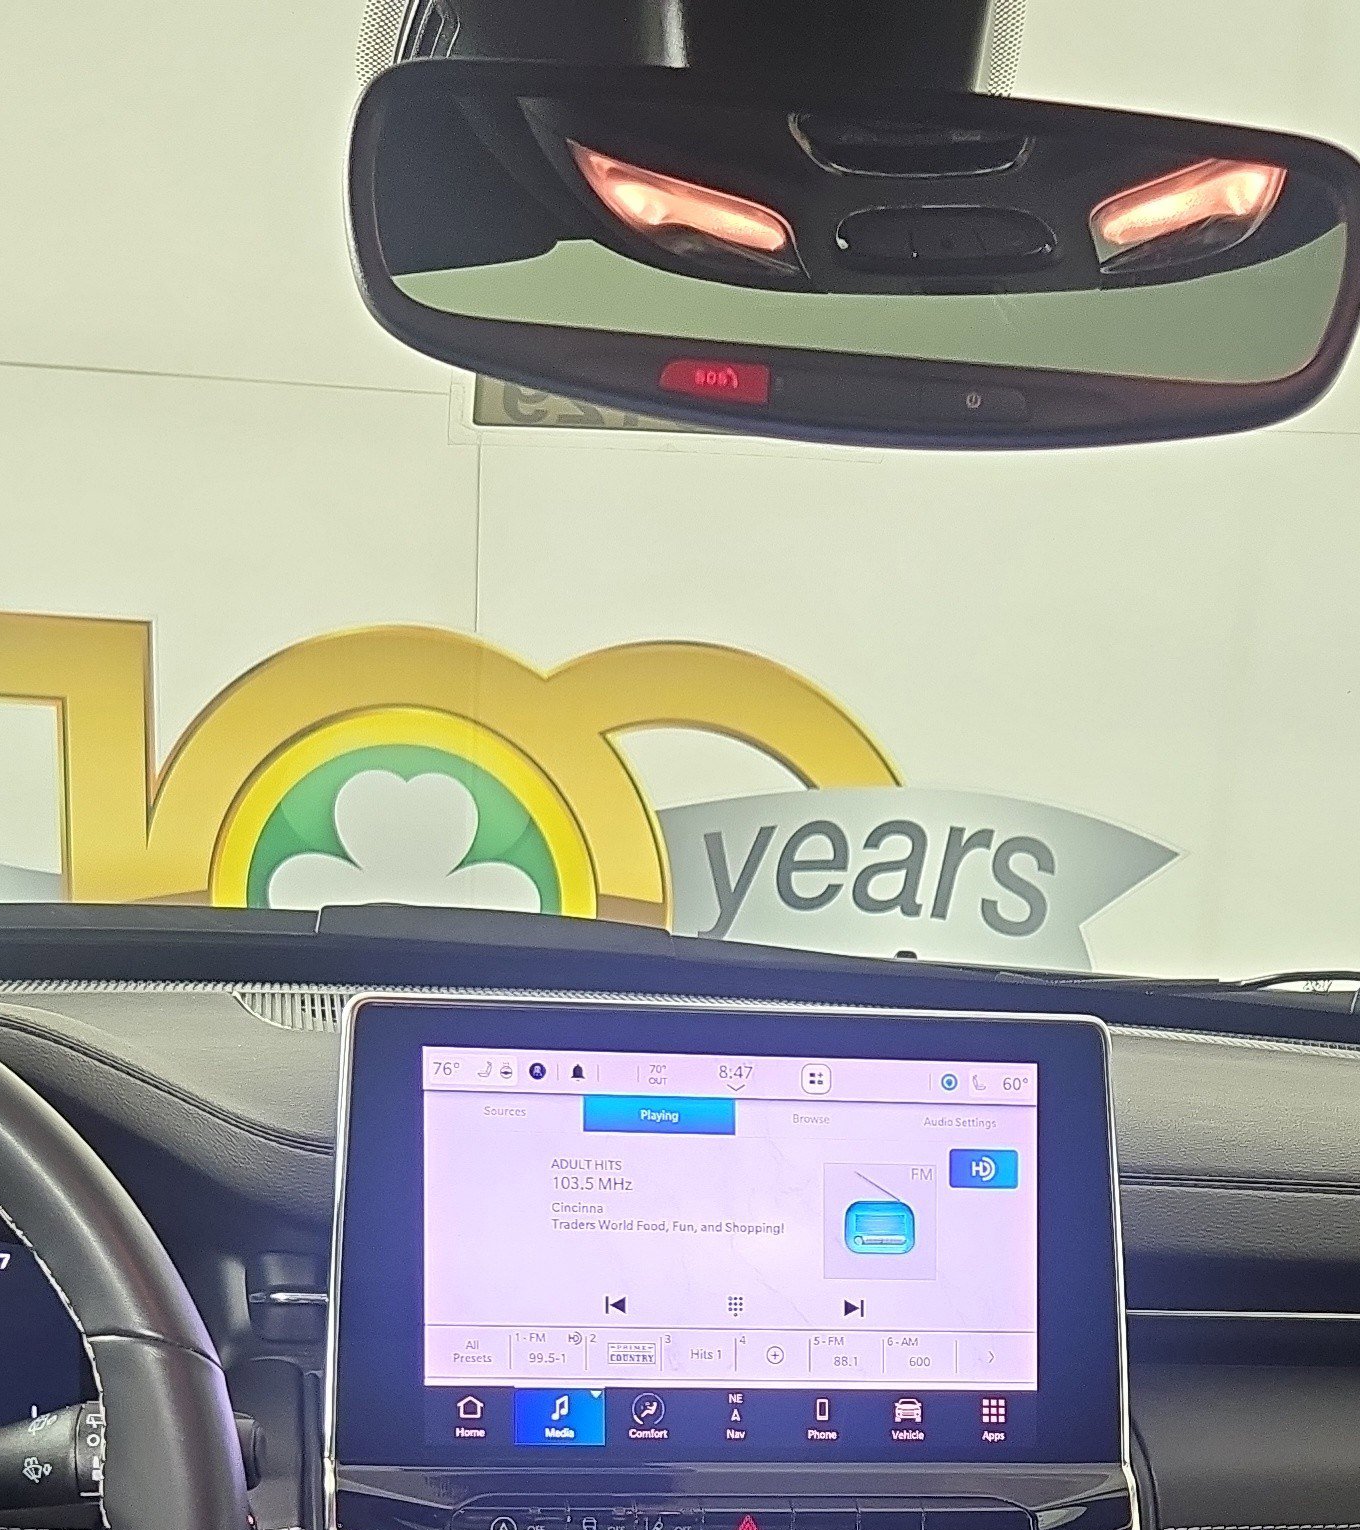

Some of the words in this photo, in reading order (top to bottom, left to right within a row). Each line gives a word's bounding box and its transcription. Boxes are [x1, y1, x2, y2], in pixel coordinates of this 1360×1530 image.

[696, 818, 1057, 936] years
[719, 1065, 753, 1080] 8:47
[648, 1077, 667, 1086] OUT
[484, 1106, 527, 1117] Sources
[640, 1109, 679, 1122] Playing
[792, 1114, 830, 1125] Browse
[923, 1117, 953, 1128] Audio
[955, 1118, 997, 1130] Settings
[551, 1158, 592, 1170] ADULT
[595, 1160, 622, 1171] HITS
[911, 1168, 933, 1181] FM
[553, 1176, 594, 1190] 103.5
[598, 1178, 633, 1191] MHz
[551, 1202, 604, 1214] Cincinna
[551, 1219, 596, 1231] Traders
[598, 1219, 634, 1231] World
[636, 1221, 669, 1233] Food,
[673, 1221, 698, 1233] Fun,
[700, 1222, 723, 1232] and
[725, 1222, 785, 1235] Shopping!
[590, 1334, 597, 1343] 2
[664, 1334, 671, 1344] 3
[739, 1336, 746, 1345] 4
[465, 1340, 479, 1350] All
[453, 1353, 492, 1363] Presets
[529, 1353, 566, 1363] 99.5-1
[610, 1353, 654, 1363] COUNTRY
[690, 1349, 713, 1360] Hits
[834, 1356, 858, 1367] 88.1
[909, 1357, 931, 1367] 600
[728, 1394, 743, 1403] NE
[455, 1427, 486, 1438] Home
[545, 1427, 575, 1439] Media
[628, 1428, 669, 1439] Comfort
[726, 1429, 746, 1440] Nav
[807, 1430, 838, 1440] Phone
[891, 1430, 925, 1441] Vehicle
[982, 1431, 1006, 1442] Apps
